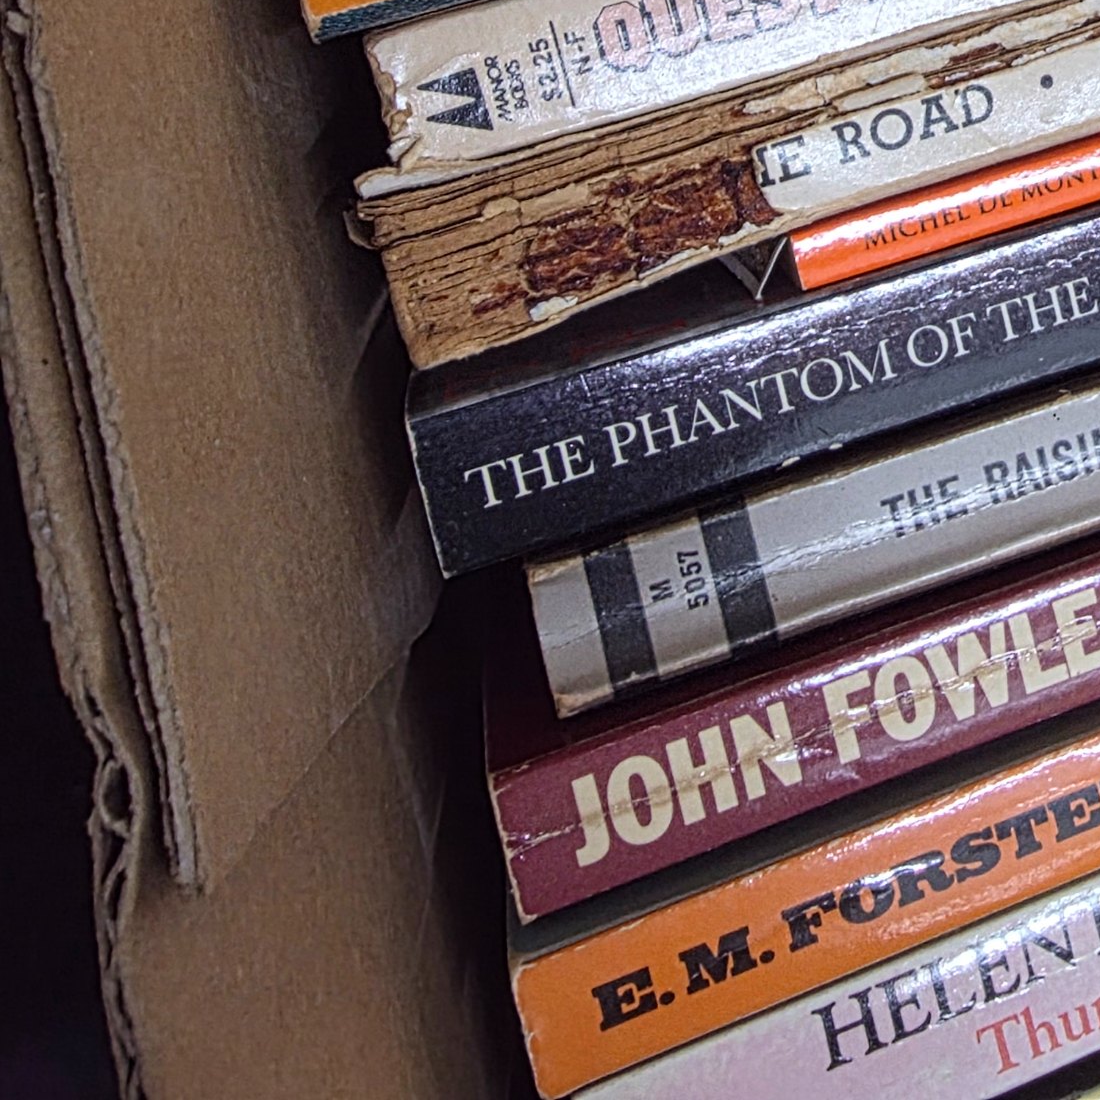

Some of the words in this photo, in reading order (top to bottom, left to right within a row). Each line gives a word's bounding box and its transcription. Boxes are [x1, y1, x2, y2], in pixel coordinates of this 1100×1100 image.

[484, 55, 512, 122] MANOR
[528, 38, 564, 102] $2.25
[831, 85, 994, 165] ROAD
[463, 436, 596, 510] THE
[602, 347, 898, 468] PHANTOM
[906, 311, 978, 370] OF
[986, 275, 1100, 343] THE
[880, 474, 969, 538] THE
[649, 579, 675, 603] M
[676, 550, 710, 609] 5057
[570, 701, 803, 868] JOHN
[591, 966, 676, 1033] E.
[678, 923, 776, 996] M.
[811, 912, 1077, 1071] HELEN
